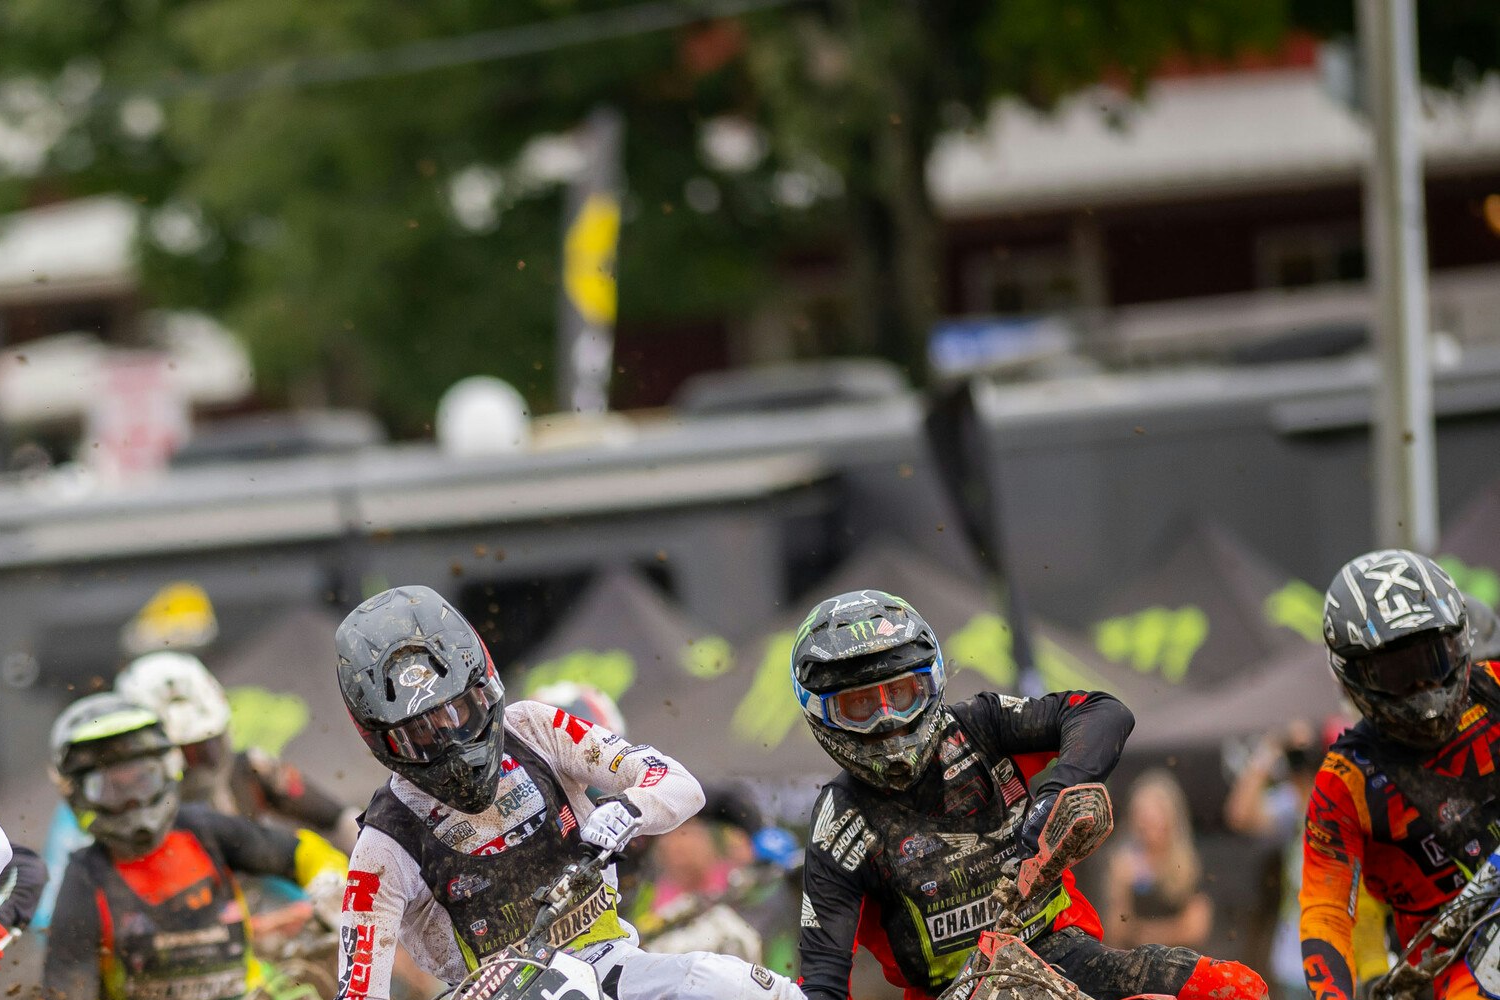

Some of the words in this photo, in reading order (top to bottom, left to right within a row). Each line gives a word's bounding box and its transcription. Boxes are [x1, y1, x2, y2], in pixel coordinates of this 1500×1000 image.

[832, 815, 865, 863] SHOWA
[944, 842, 987, 864] HONDA
[927, 894, 967, 913] AMATEUR
